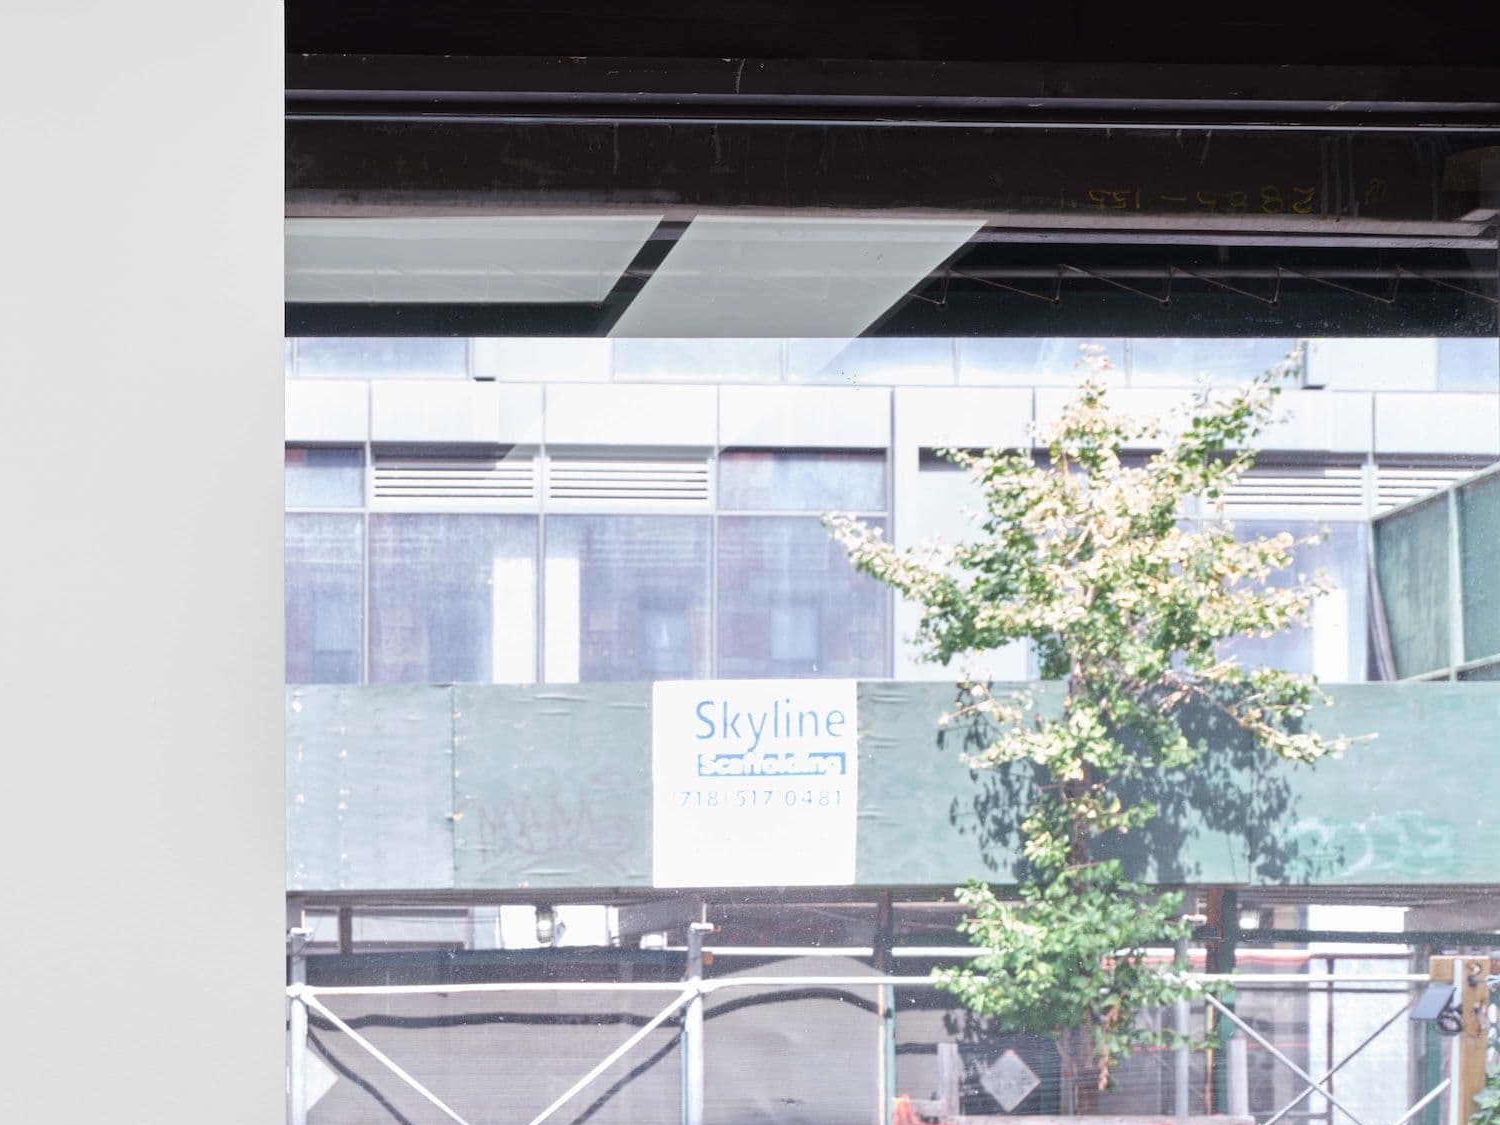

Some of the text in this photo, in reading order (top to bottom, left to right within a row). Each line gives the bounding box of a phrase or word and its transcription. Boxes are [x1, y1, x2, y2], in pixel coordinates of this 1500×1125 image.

[695, 698, 845, 752] Skyline
[738, 790, 773, 807] 517
[785, 790, 841, 807] 0481
